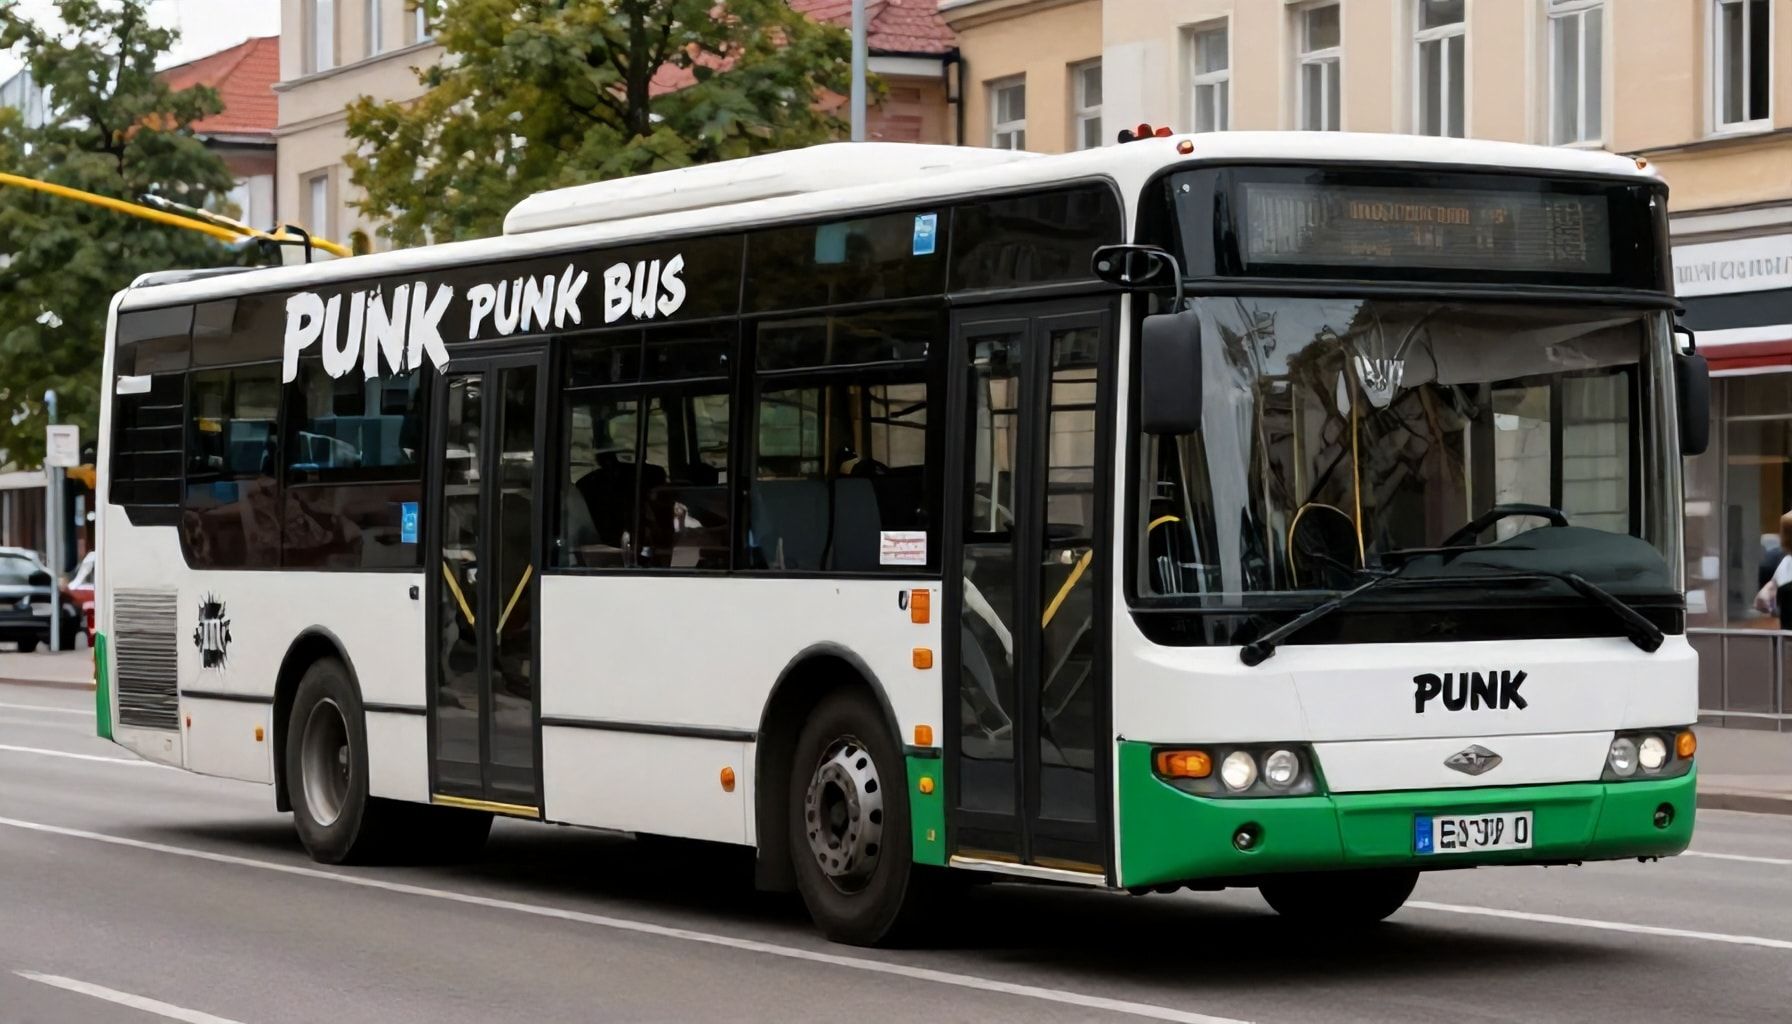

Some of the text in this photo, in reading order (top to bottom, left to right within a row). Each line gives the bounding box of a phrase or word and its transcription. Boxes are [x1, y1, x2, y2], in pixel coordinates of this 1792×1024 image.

[282, 253, 686, 384] PUNK PUNK BUS
[1413, 670, 1528, 714] PUNK
